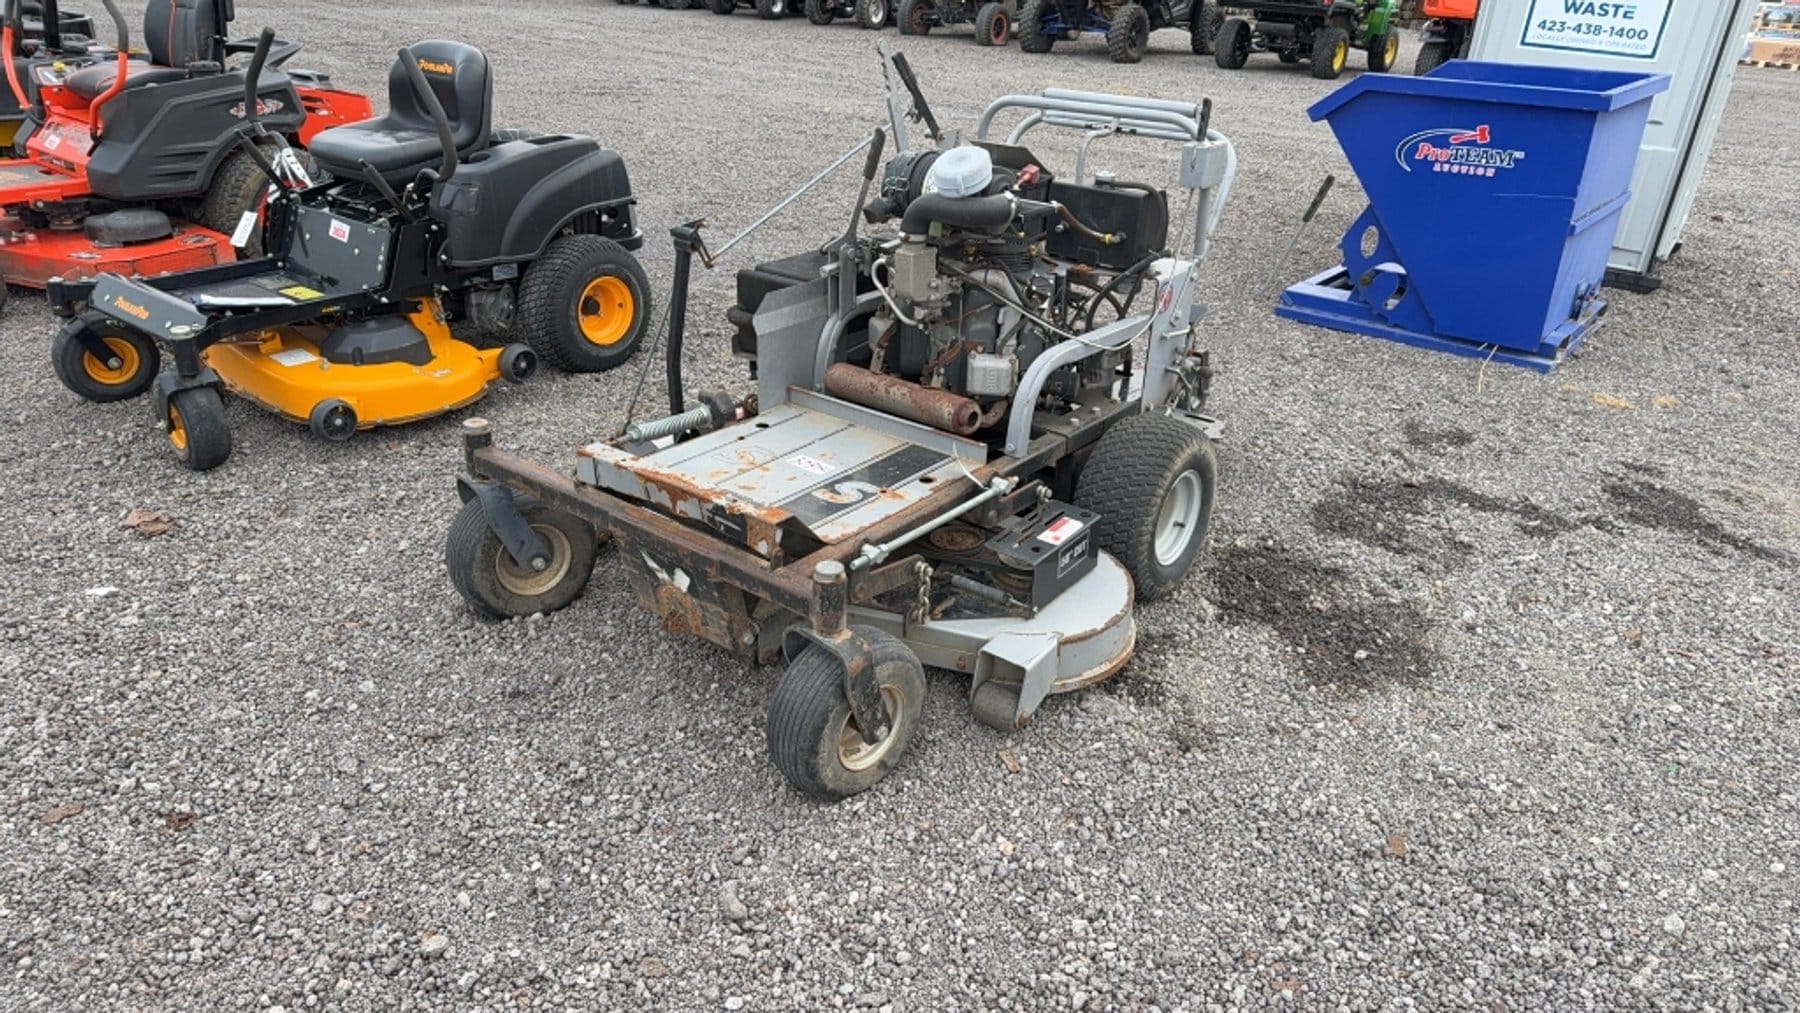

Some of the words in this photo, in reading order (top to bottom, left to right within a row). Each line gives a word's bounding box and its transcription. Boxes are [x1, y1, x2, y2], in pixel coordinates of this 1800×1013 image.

[1563, 0, 1637, 20] WASTE
[1537, 19, 1649, 41] 423-438-1400
[1432, 161, 1496, 177] AUCTION
